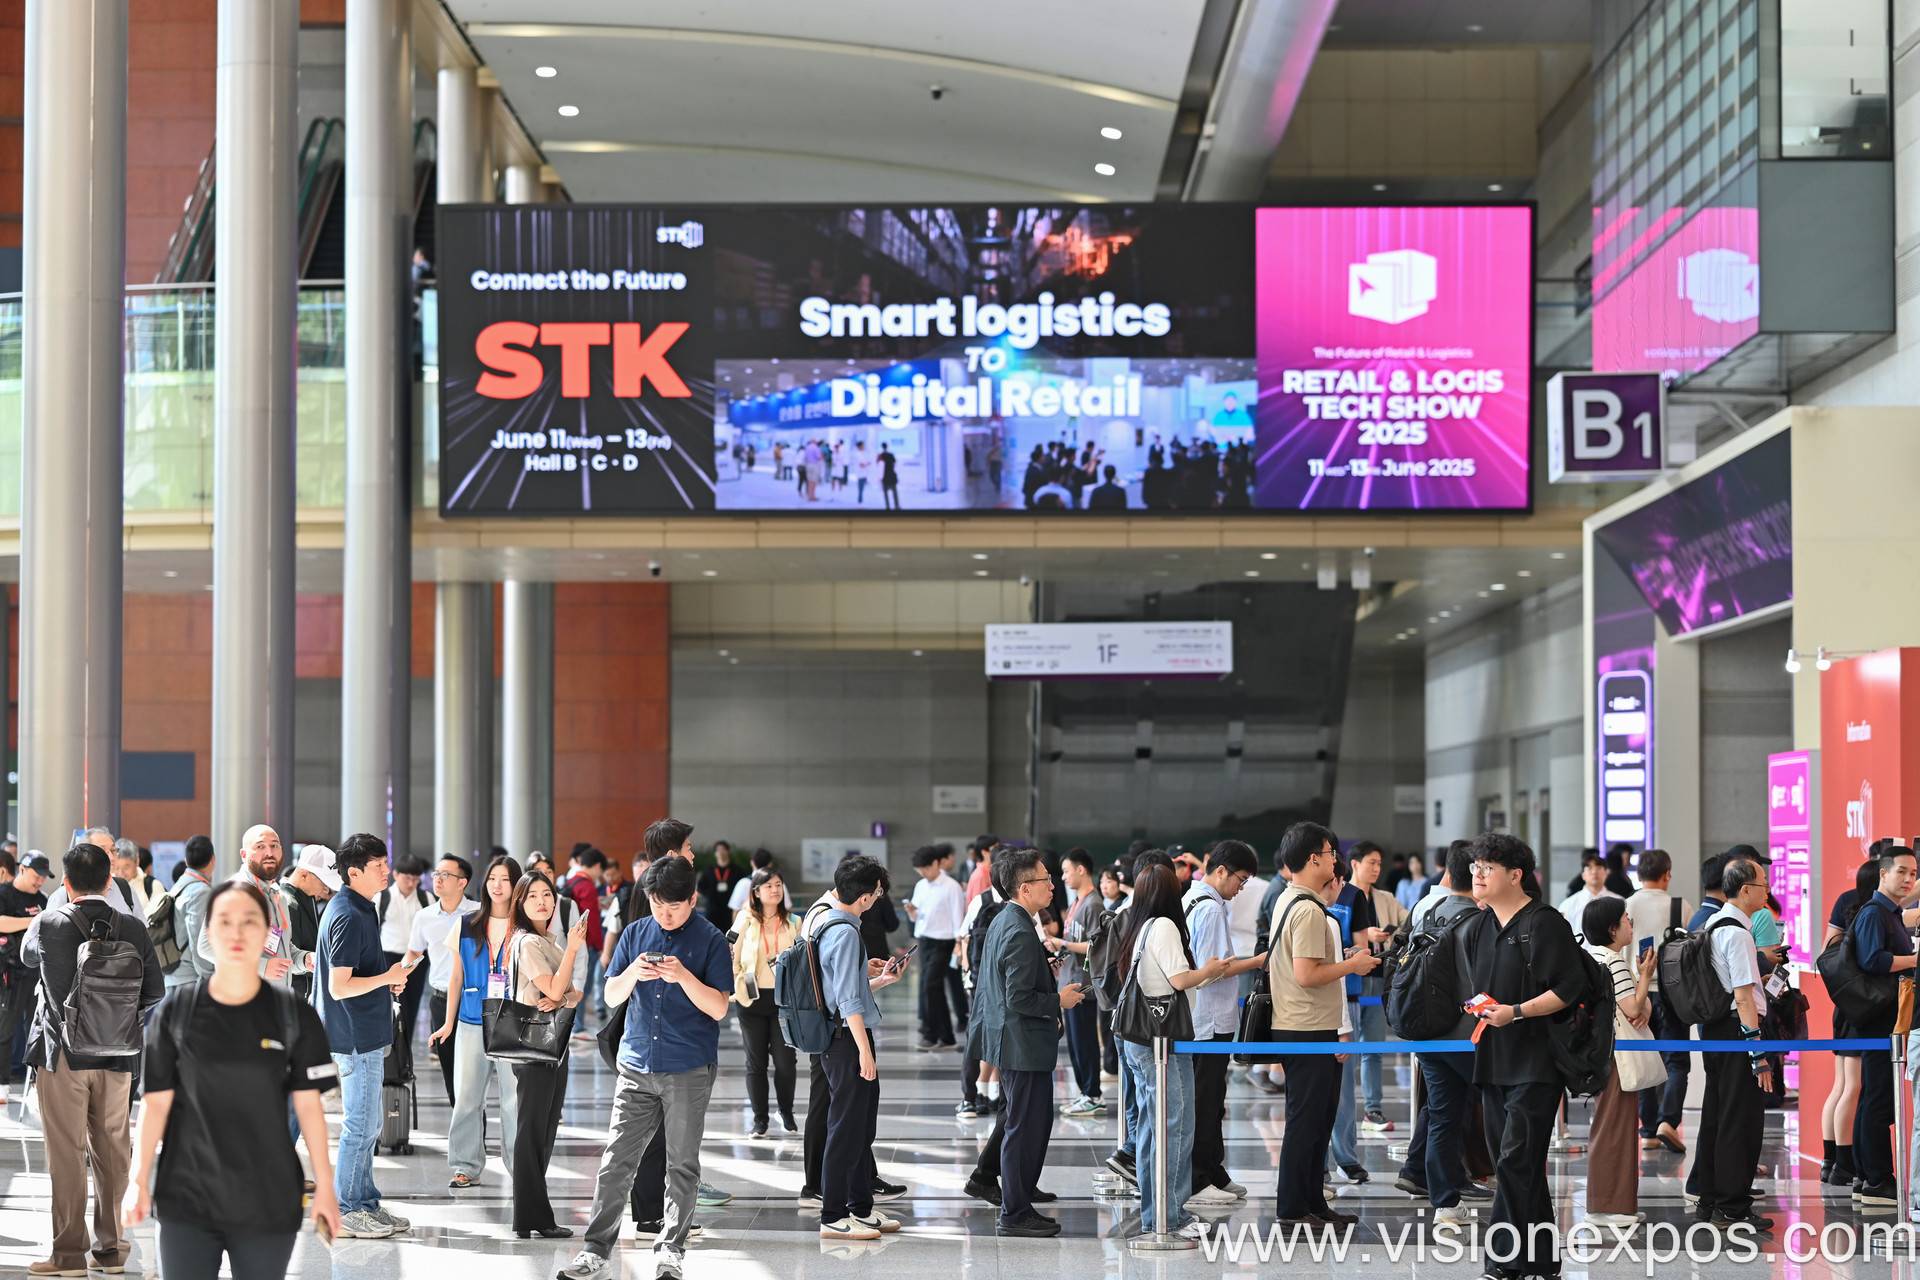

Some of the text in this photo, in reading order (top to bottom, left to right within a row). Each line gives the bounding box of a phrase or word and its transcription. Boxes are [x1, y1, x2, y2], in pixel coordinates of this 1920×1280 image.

[471, 269, 687, 290] Connect the Future
[799, 292, 1171, 349] Smart logistics
[475, 321, 693, 400] STK
[964, 346, 1007, 373] TO
[1282, 369, 1504, 394] RETAIL & LOGIS
[830, 374, 1141, 429] Digital Retail
[1302, 395, 1483, 419] TECH SHOW
[491, 429, 547, 449] June
[1357, 421, 1427, 445] 2025
[525, 454, 561, 471] Hall
[564, 454, 577, 471] B
[591, 454, 608, 471] C
[623, 454, 638, 471] D
[1382, 458, 1428, 477] June
[1428, 458, 1475, 477] 2025
[1097, 644, 1119, 664] 1F
[1846, 800, 1866, 839] STK
